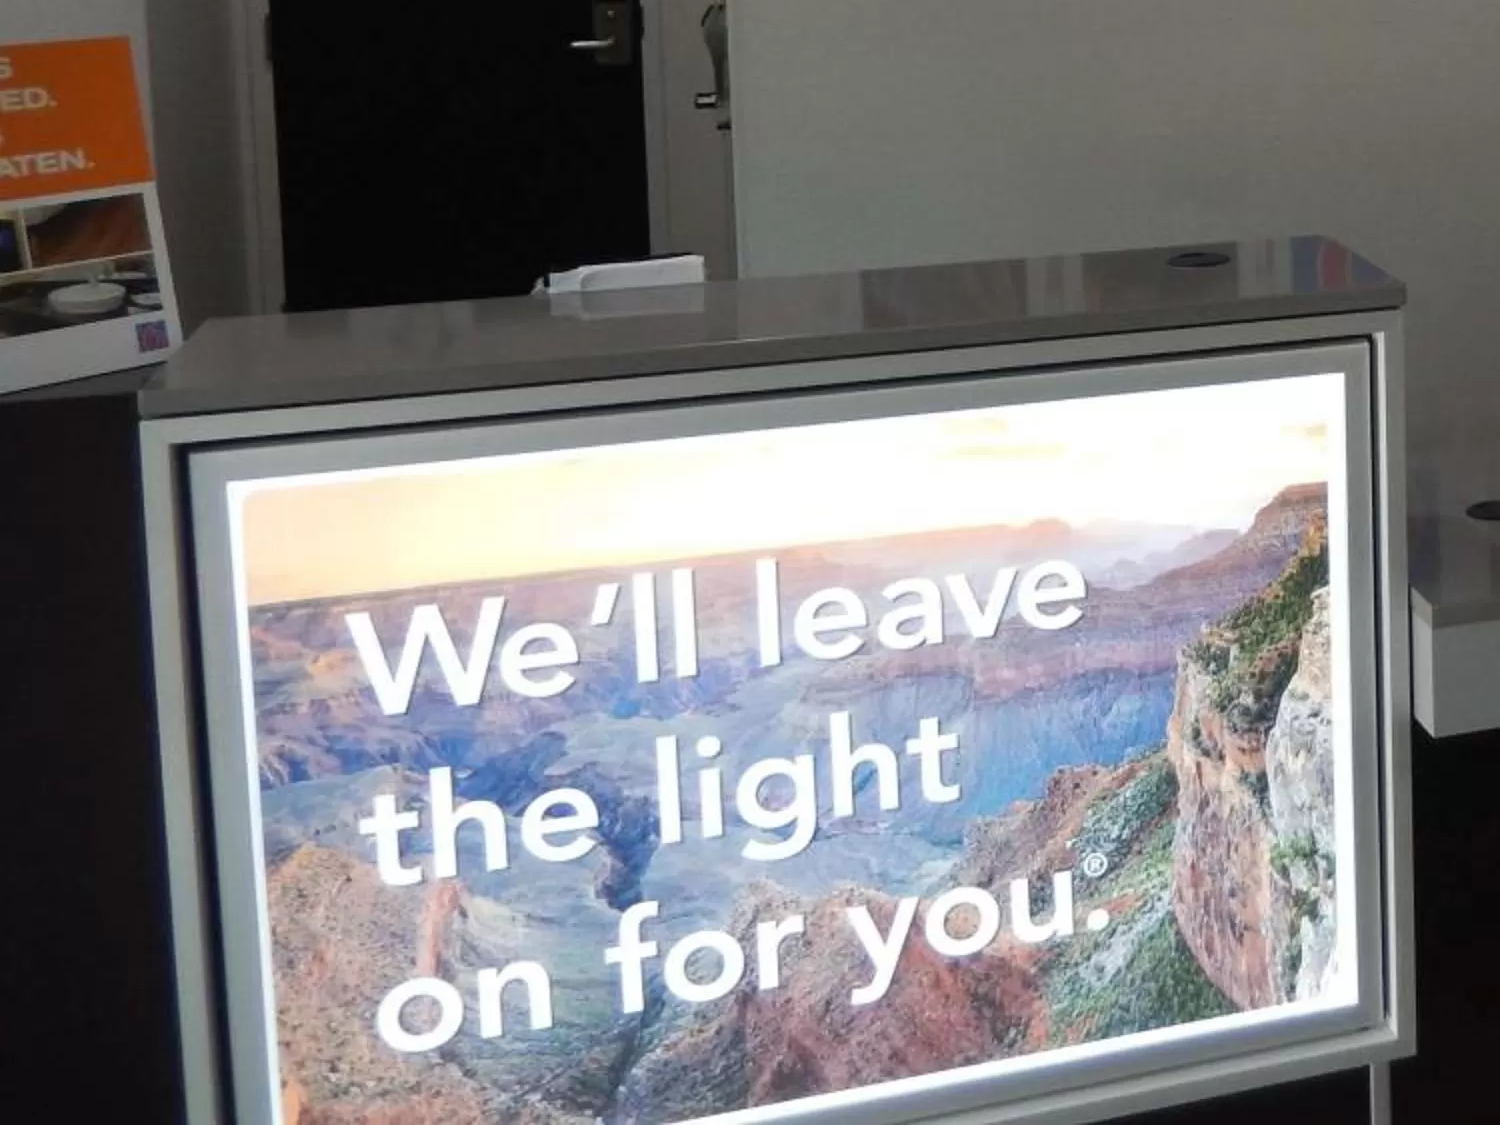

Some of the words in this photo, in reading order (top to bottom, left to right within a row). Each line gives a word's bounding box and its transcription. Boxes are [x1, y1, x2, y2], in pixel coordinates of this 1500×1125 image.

[344, 566, 698, 715] We'll
[755, 558, 1087, 668] leave
[358, 766, 599, 887] the
[656, 710, 960, 861] light
[377, 960, 553, 1053] on
[604, 900, 804, 1014] for
